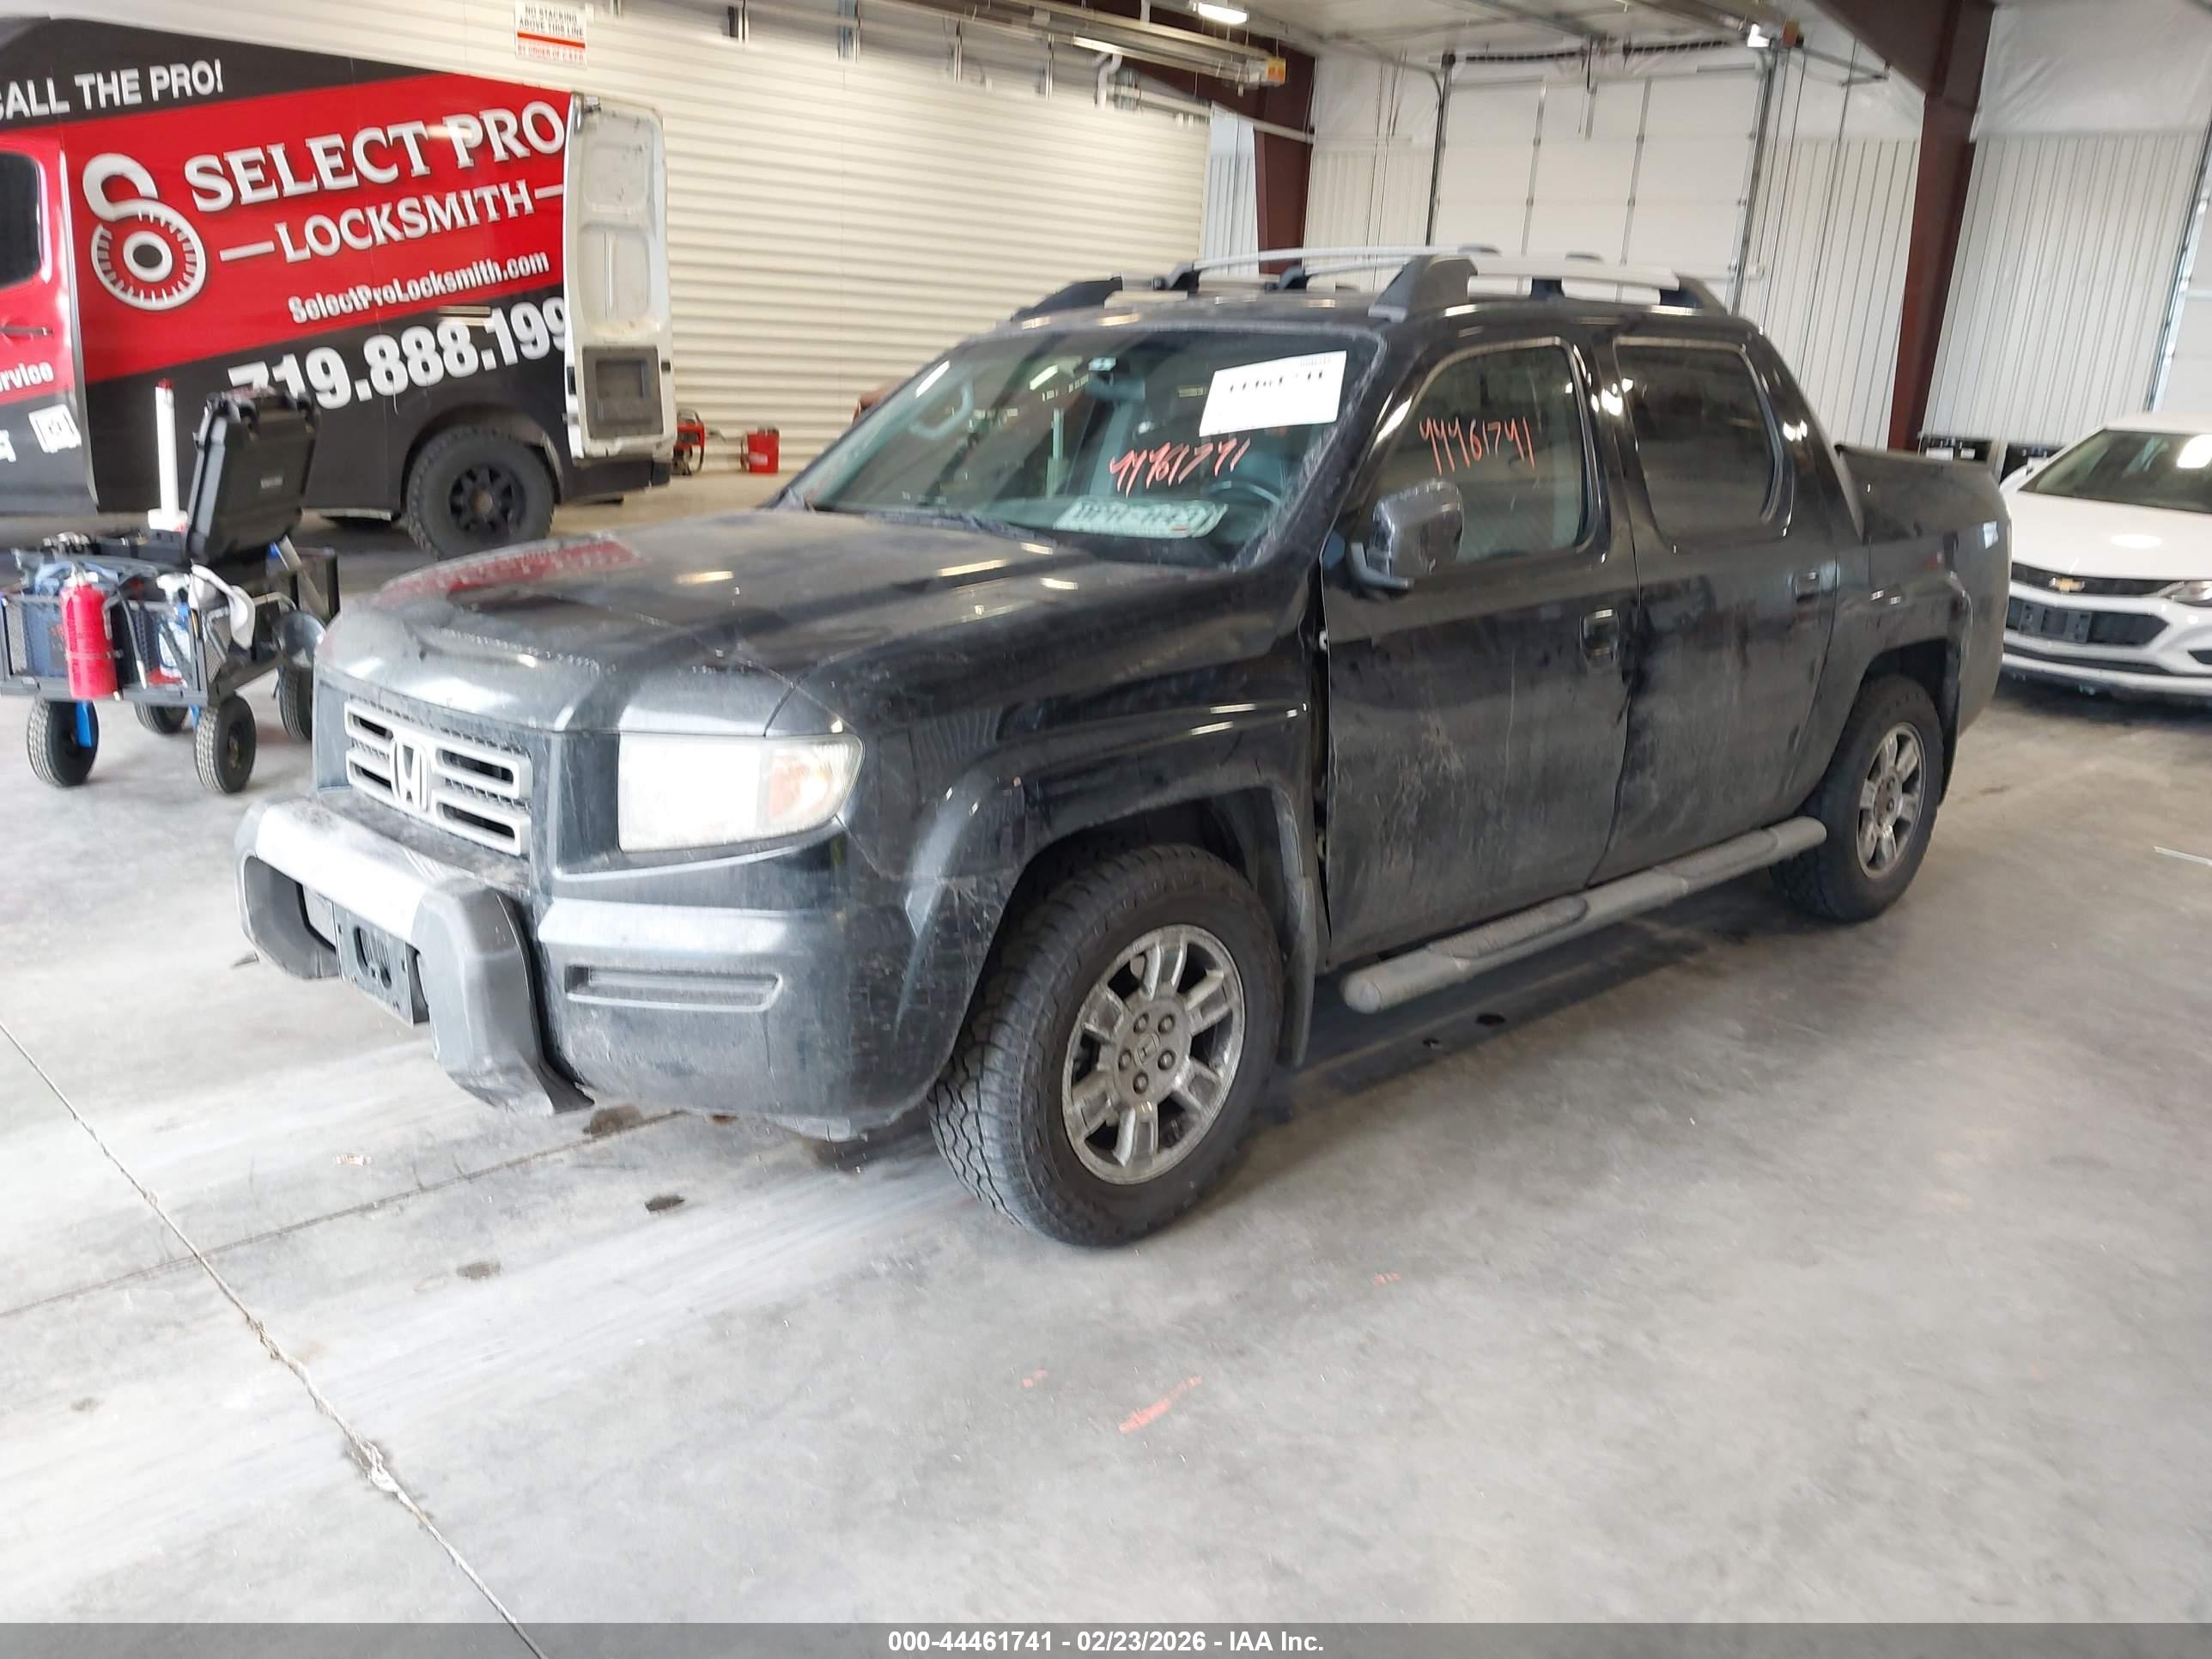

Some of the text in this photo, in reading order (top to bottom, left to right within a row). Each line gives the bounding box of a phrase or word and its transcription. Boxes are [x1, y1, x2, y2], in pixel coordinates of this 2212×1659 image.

[0, 58, 223, 122] ALL THE PRO!
[185, 100, 565, 212] SELECT PRO
[274, 179, 535, 263] LOCKSMITH
[288, 252, 550, 324] SelectProLocksmith.com
[0, 362, 54, 392] rvice
[228, 296, 564, 410] 719.888.199
